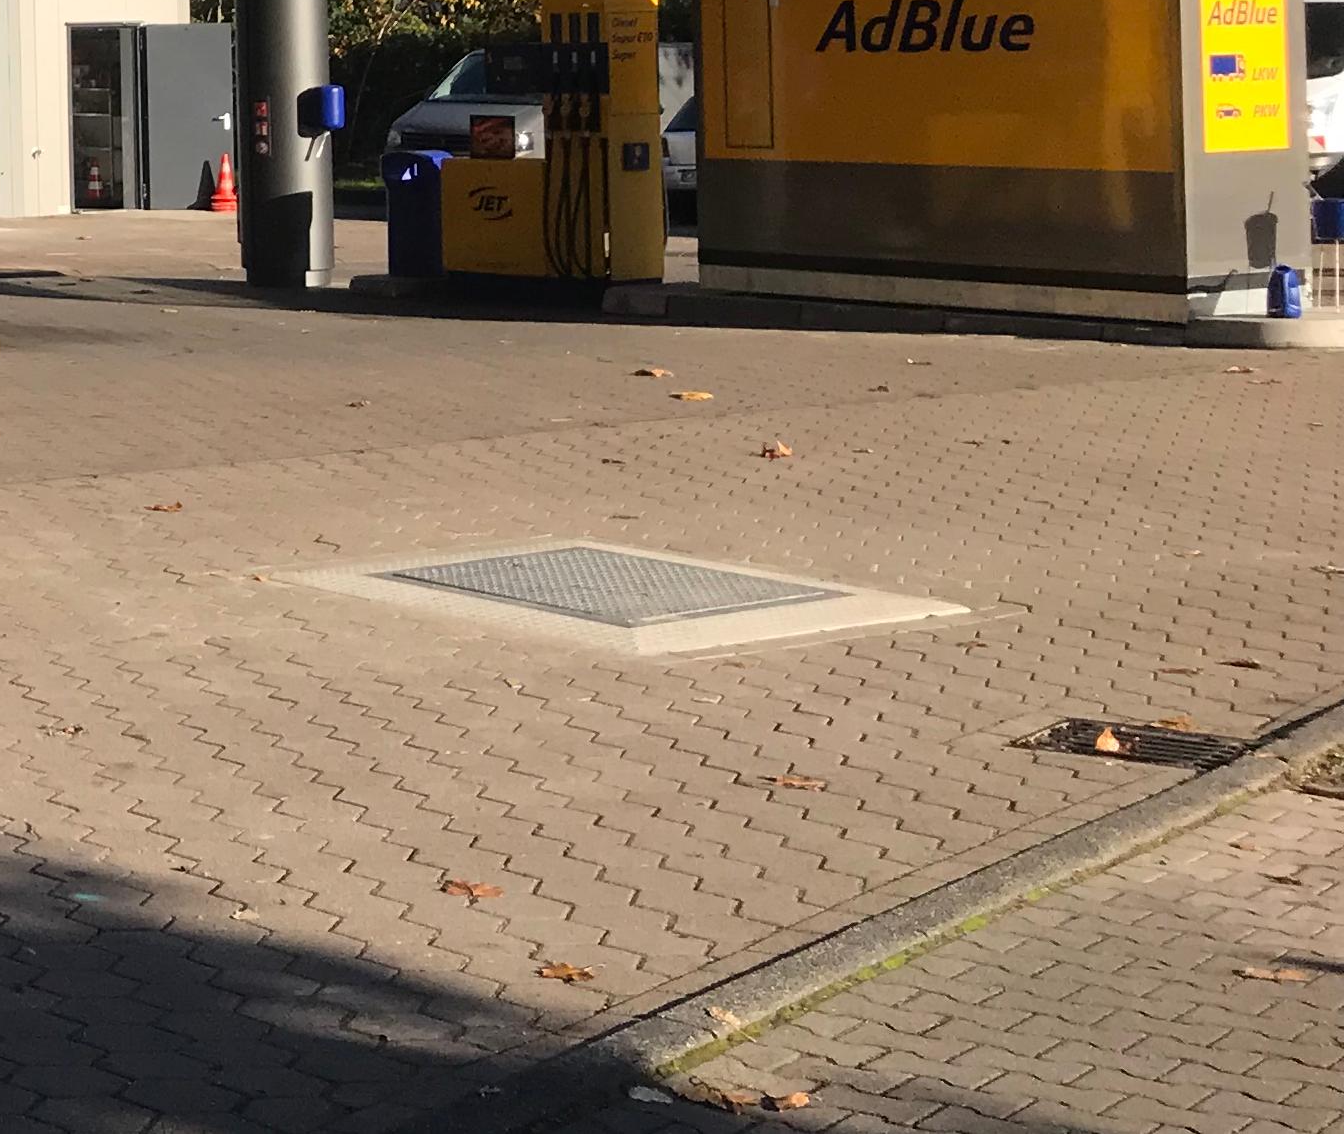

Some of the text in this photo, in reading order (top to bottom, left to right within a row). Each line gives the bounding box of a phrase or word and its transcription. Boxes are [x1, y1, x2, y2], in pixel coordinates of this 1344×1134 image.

[1207, 0, 1278, 26] AdBlue
[1252, 67, 1278, 81] LKW
[473, 195, 509, 211] JET
